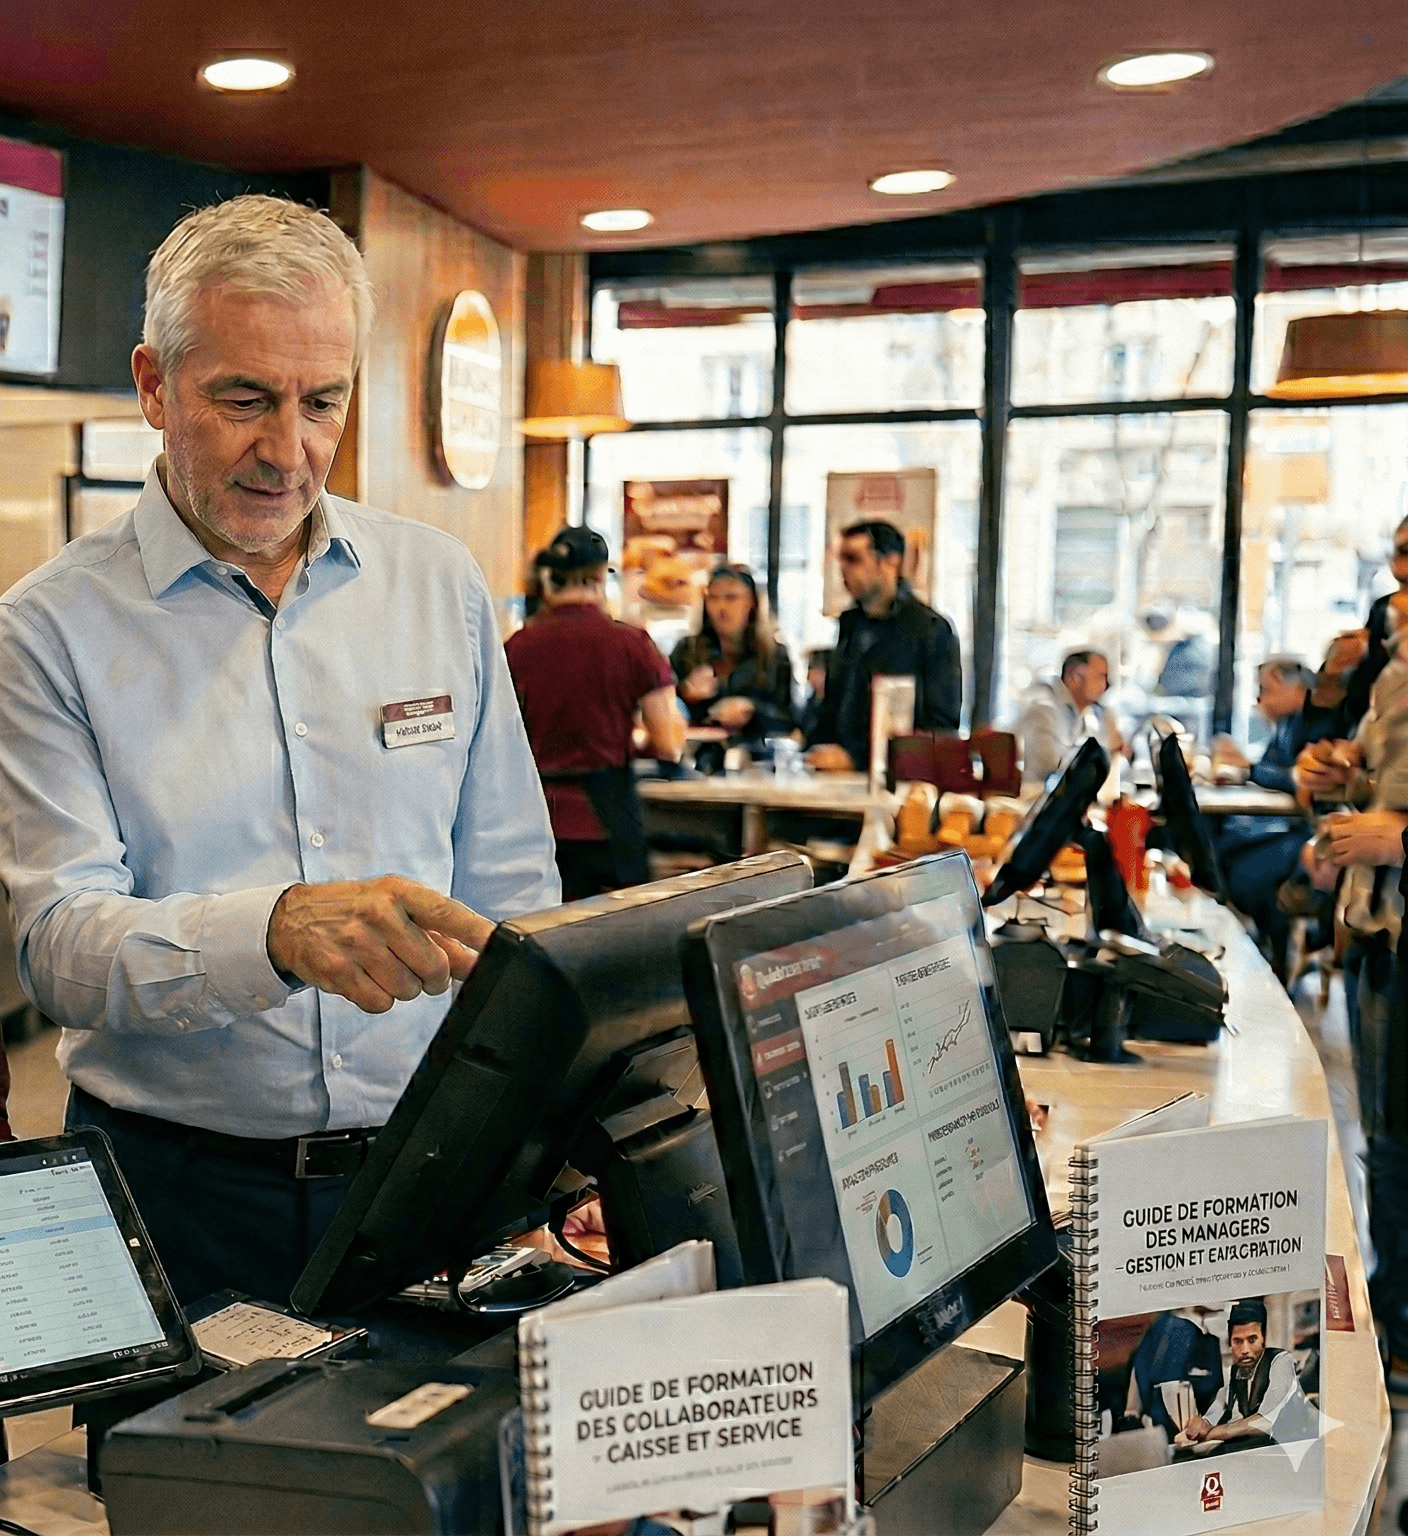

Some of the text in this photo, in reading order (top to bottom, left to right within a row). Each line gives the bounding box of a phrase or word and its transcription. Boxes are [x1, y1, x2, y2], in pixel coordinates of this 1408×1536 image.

[1123, 1190, 1298, 1227] GUIDE DE FORMATION
[1146, 1217, 1270, 1248] DES MANAGERS
[1189, 1249, 1205, 1266] ET
[580, 1361, 813, 1411] GUIDE DE FORMATION
[577, 1388, 818, 1441] DES COLLABORATEURS
[607, 1417, 802, 1463] CAISSE ET SERVICE
